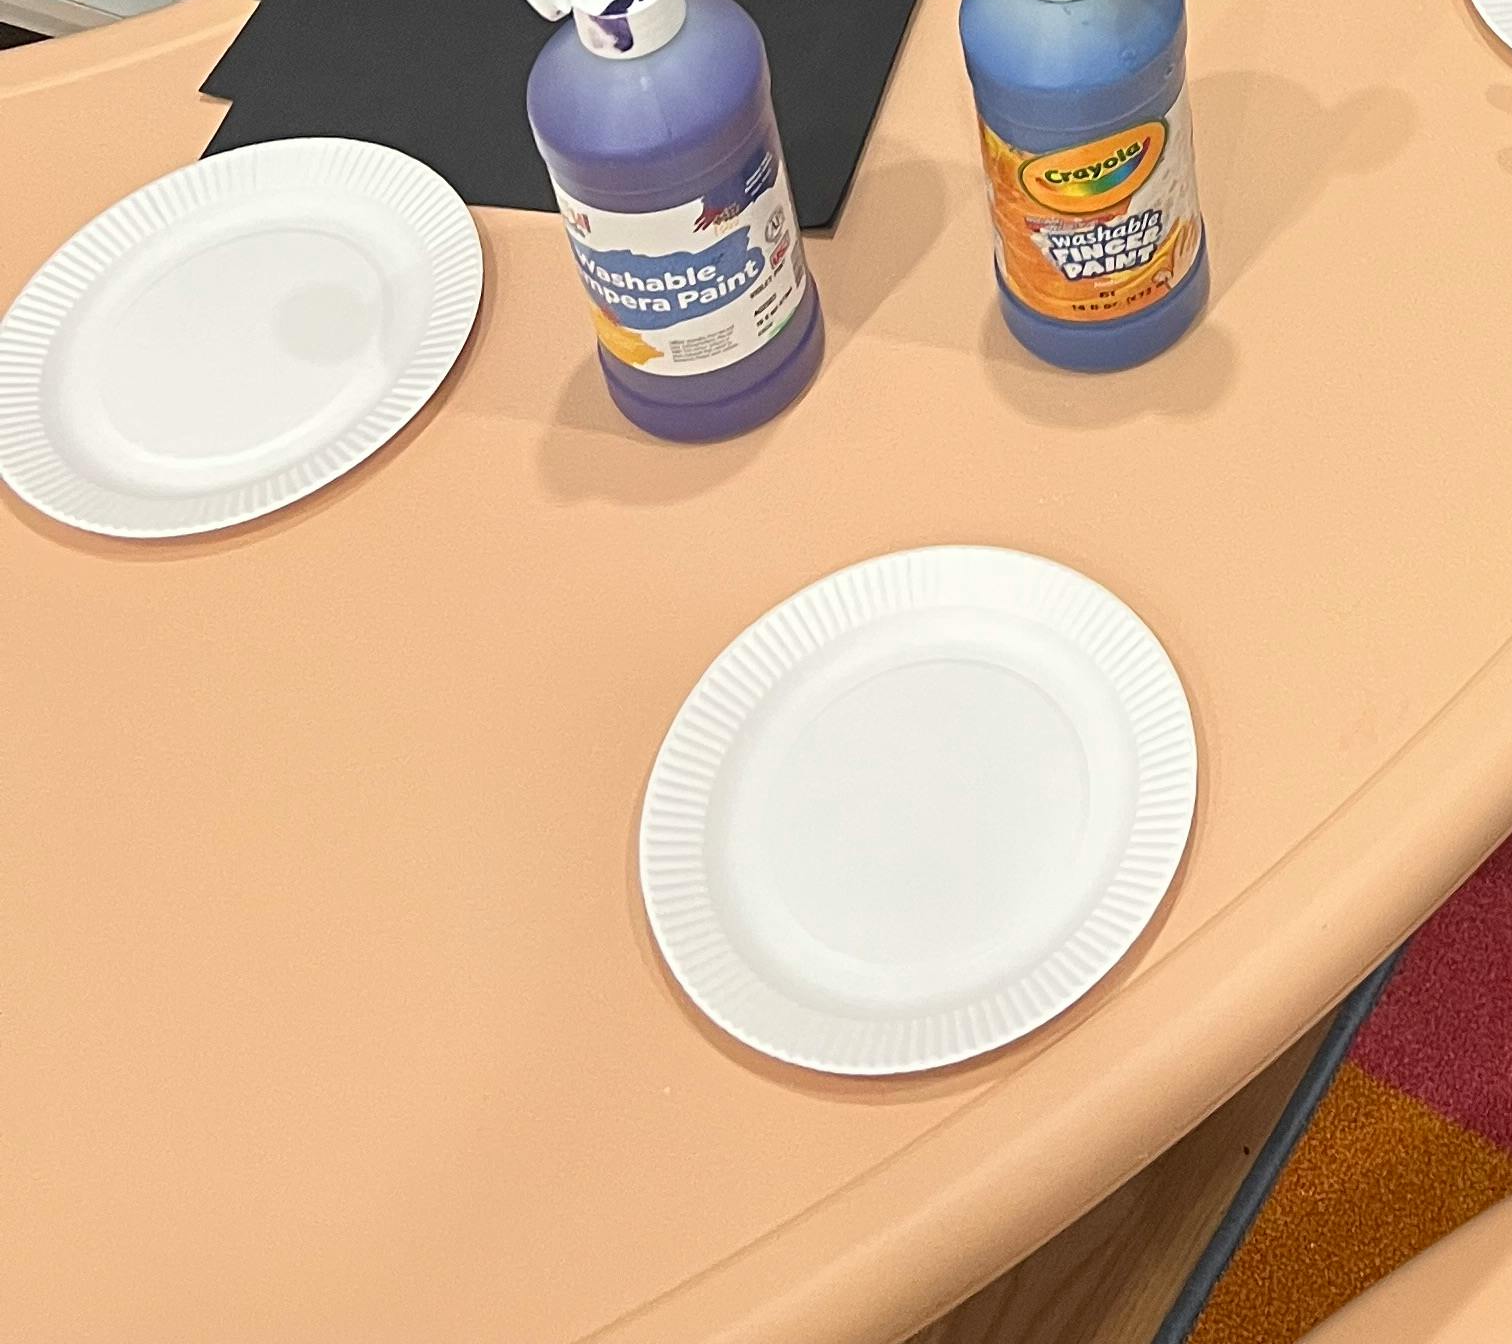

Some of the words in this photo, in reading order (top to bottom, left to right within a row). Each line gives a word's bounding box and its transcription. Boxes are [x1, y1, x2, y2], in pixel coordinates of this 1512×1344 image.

[1044, 141, 1141, 184] Crayola
[1051, 212, 1162, 248] washable
[1052, 225, 1161, 265] FINGER
[577, 250, 718, 293] Washable
[1062, 244, 1156, 280] PAINT
[676, 259, 760, 310] Paint
